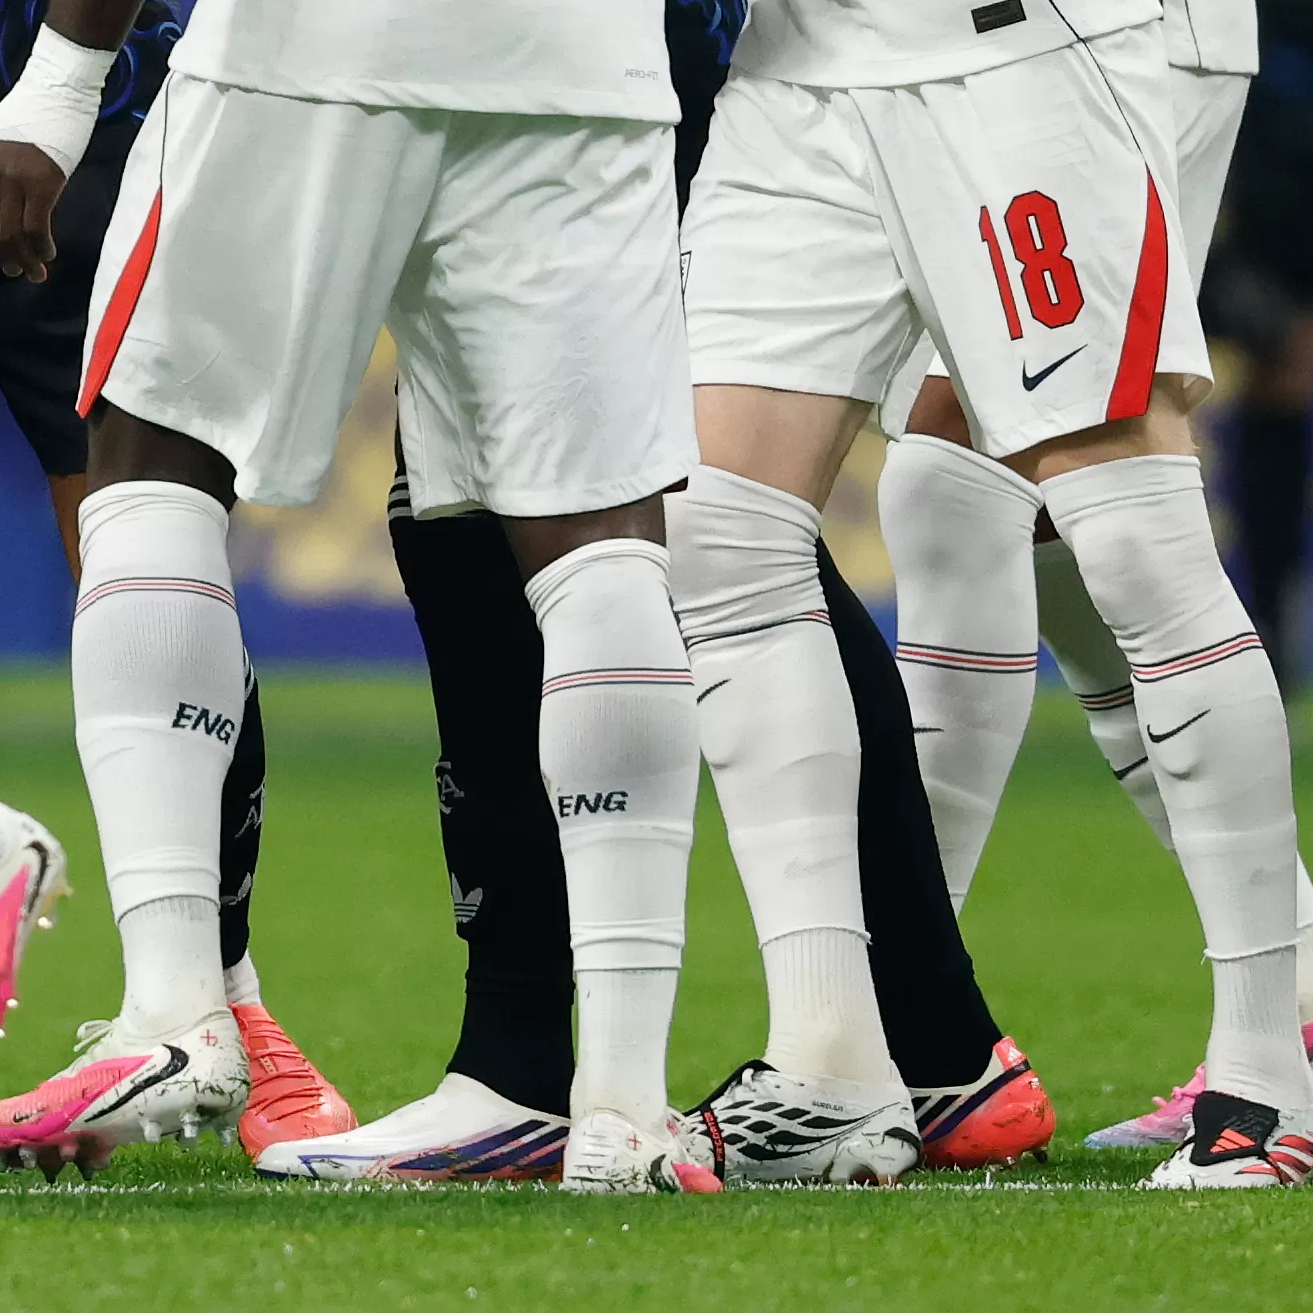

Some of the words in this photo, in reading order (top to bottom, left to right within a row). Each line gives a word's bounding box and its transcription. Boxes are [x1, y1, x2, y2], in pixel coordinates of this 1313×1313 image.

[978, 190, 1085, 341] 18
[171, 701, 236, 745] ENG
[558, 790, 629, 818] ENG
